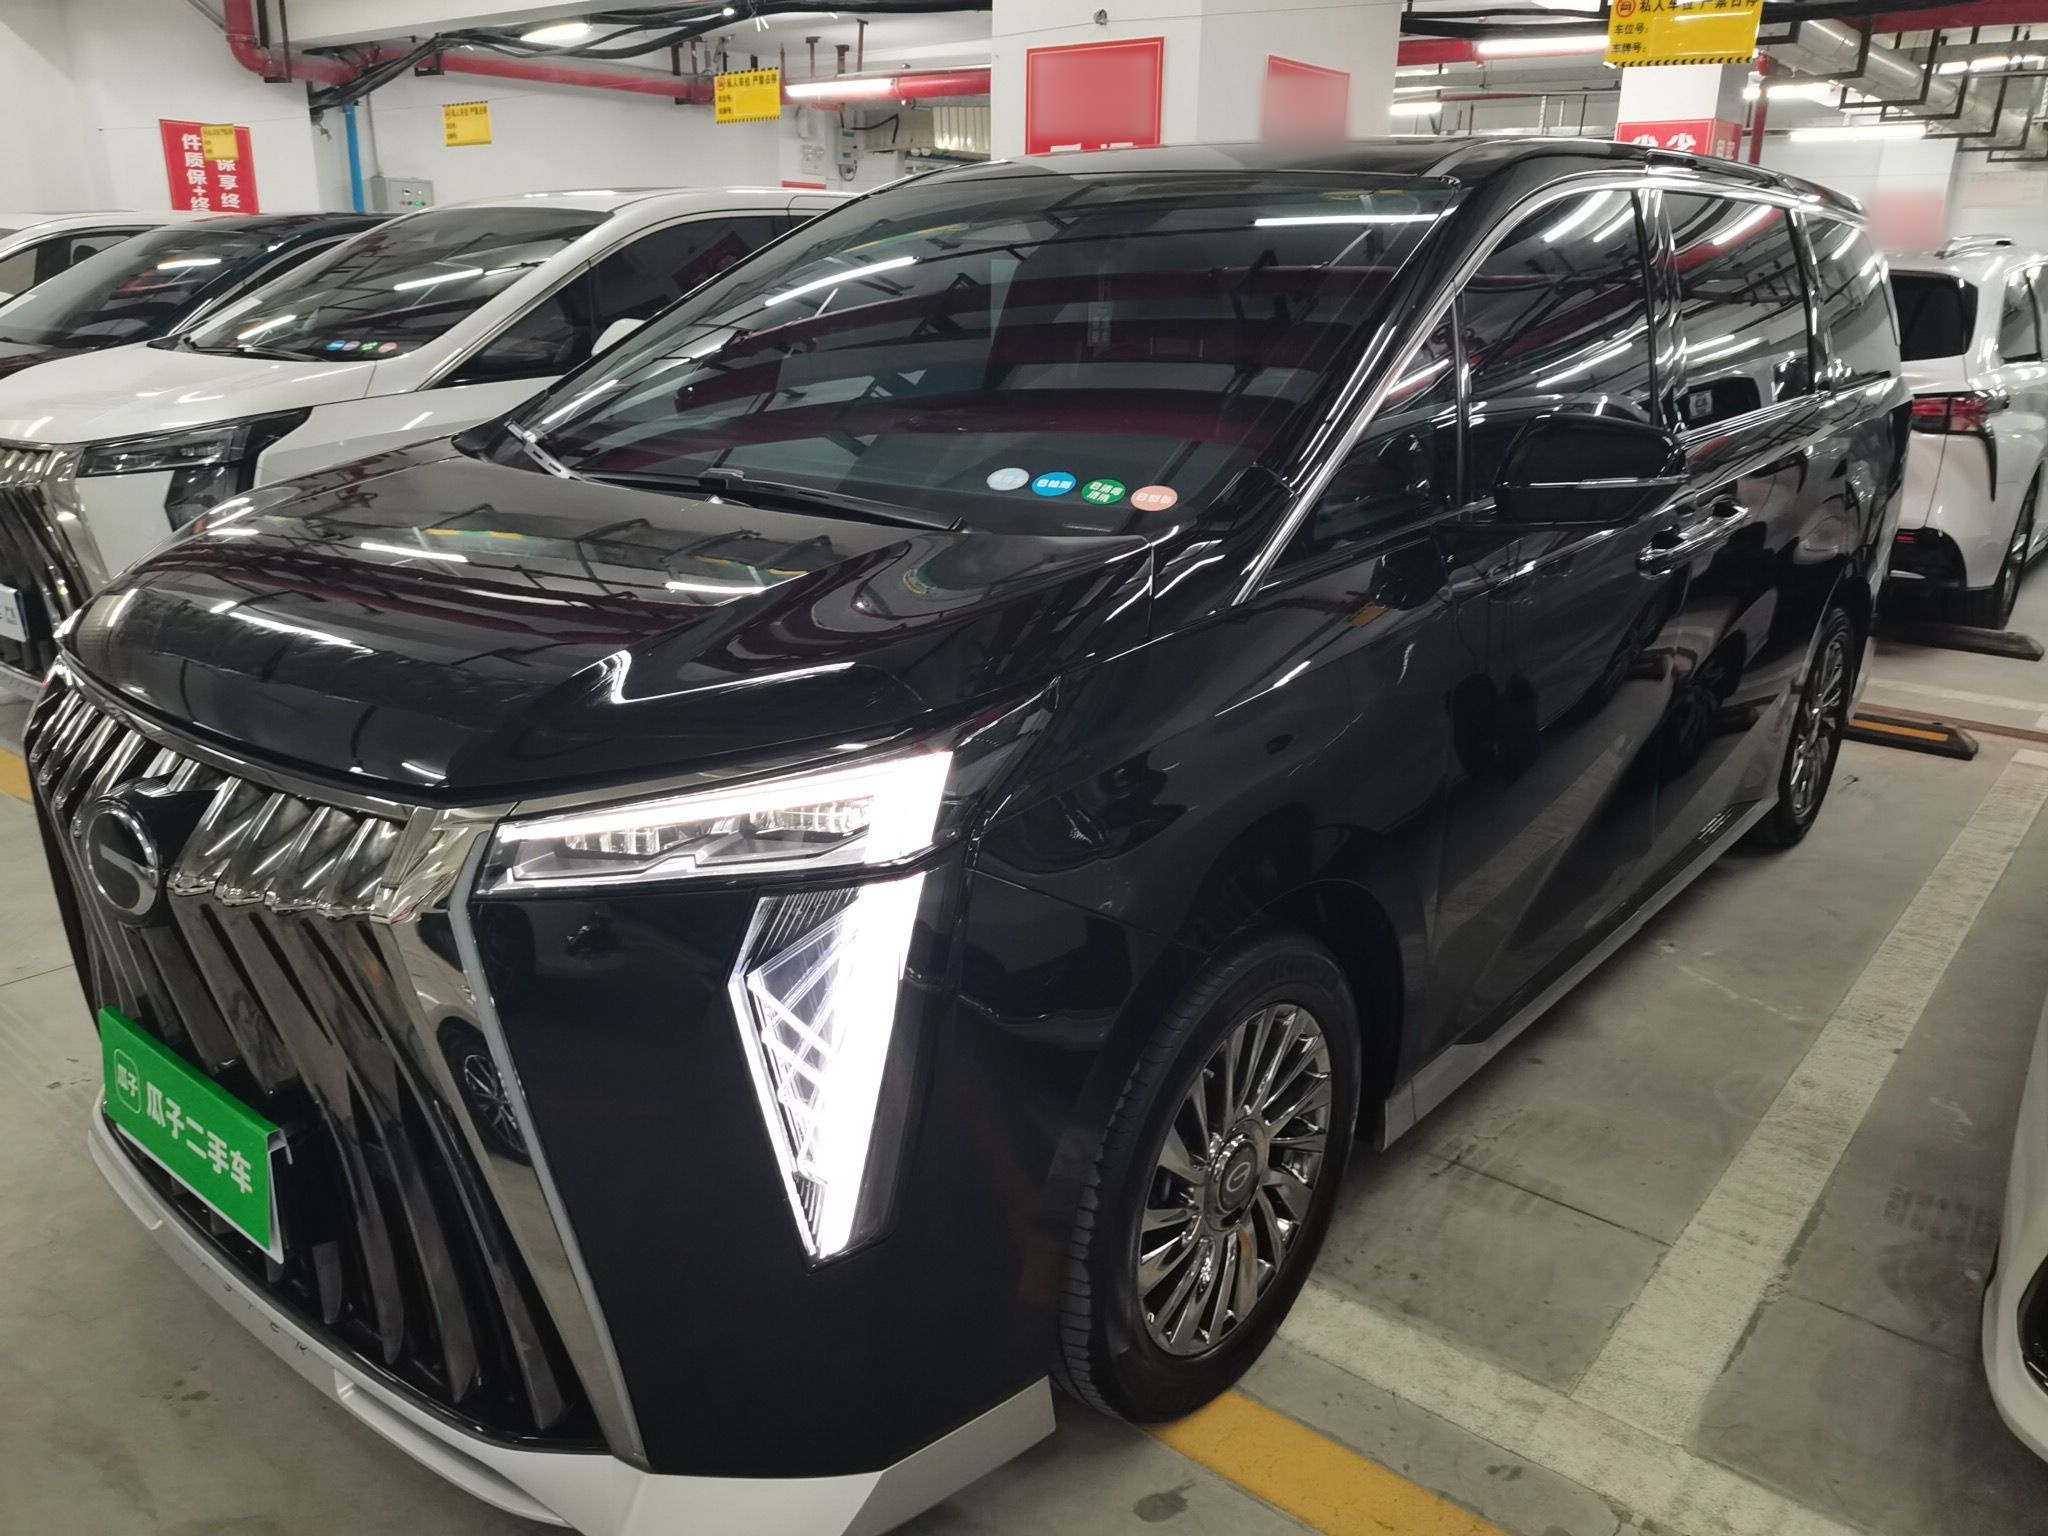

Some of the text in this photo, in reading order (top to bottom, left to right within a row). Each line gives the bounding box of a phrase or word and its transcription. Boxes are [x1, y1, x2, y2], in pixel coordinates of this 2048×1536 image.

[117, 1063, 139, 1097] 瓜子
[146, 1081, 253, 1194] 瓜子二手车
